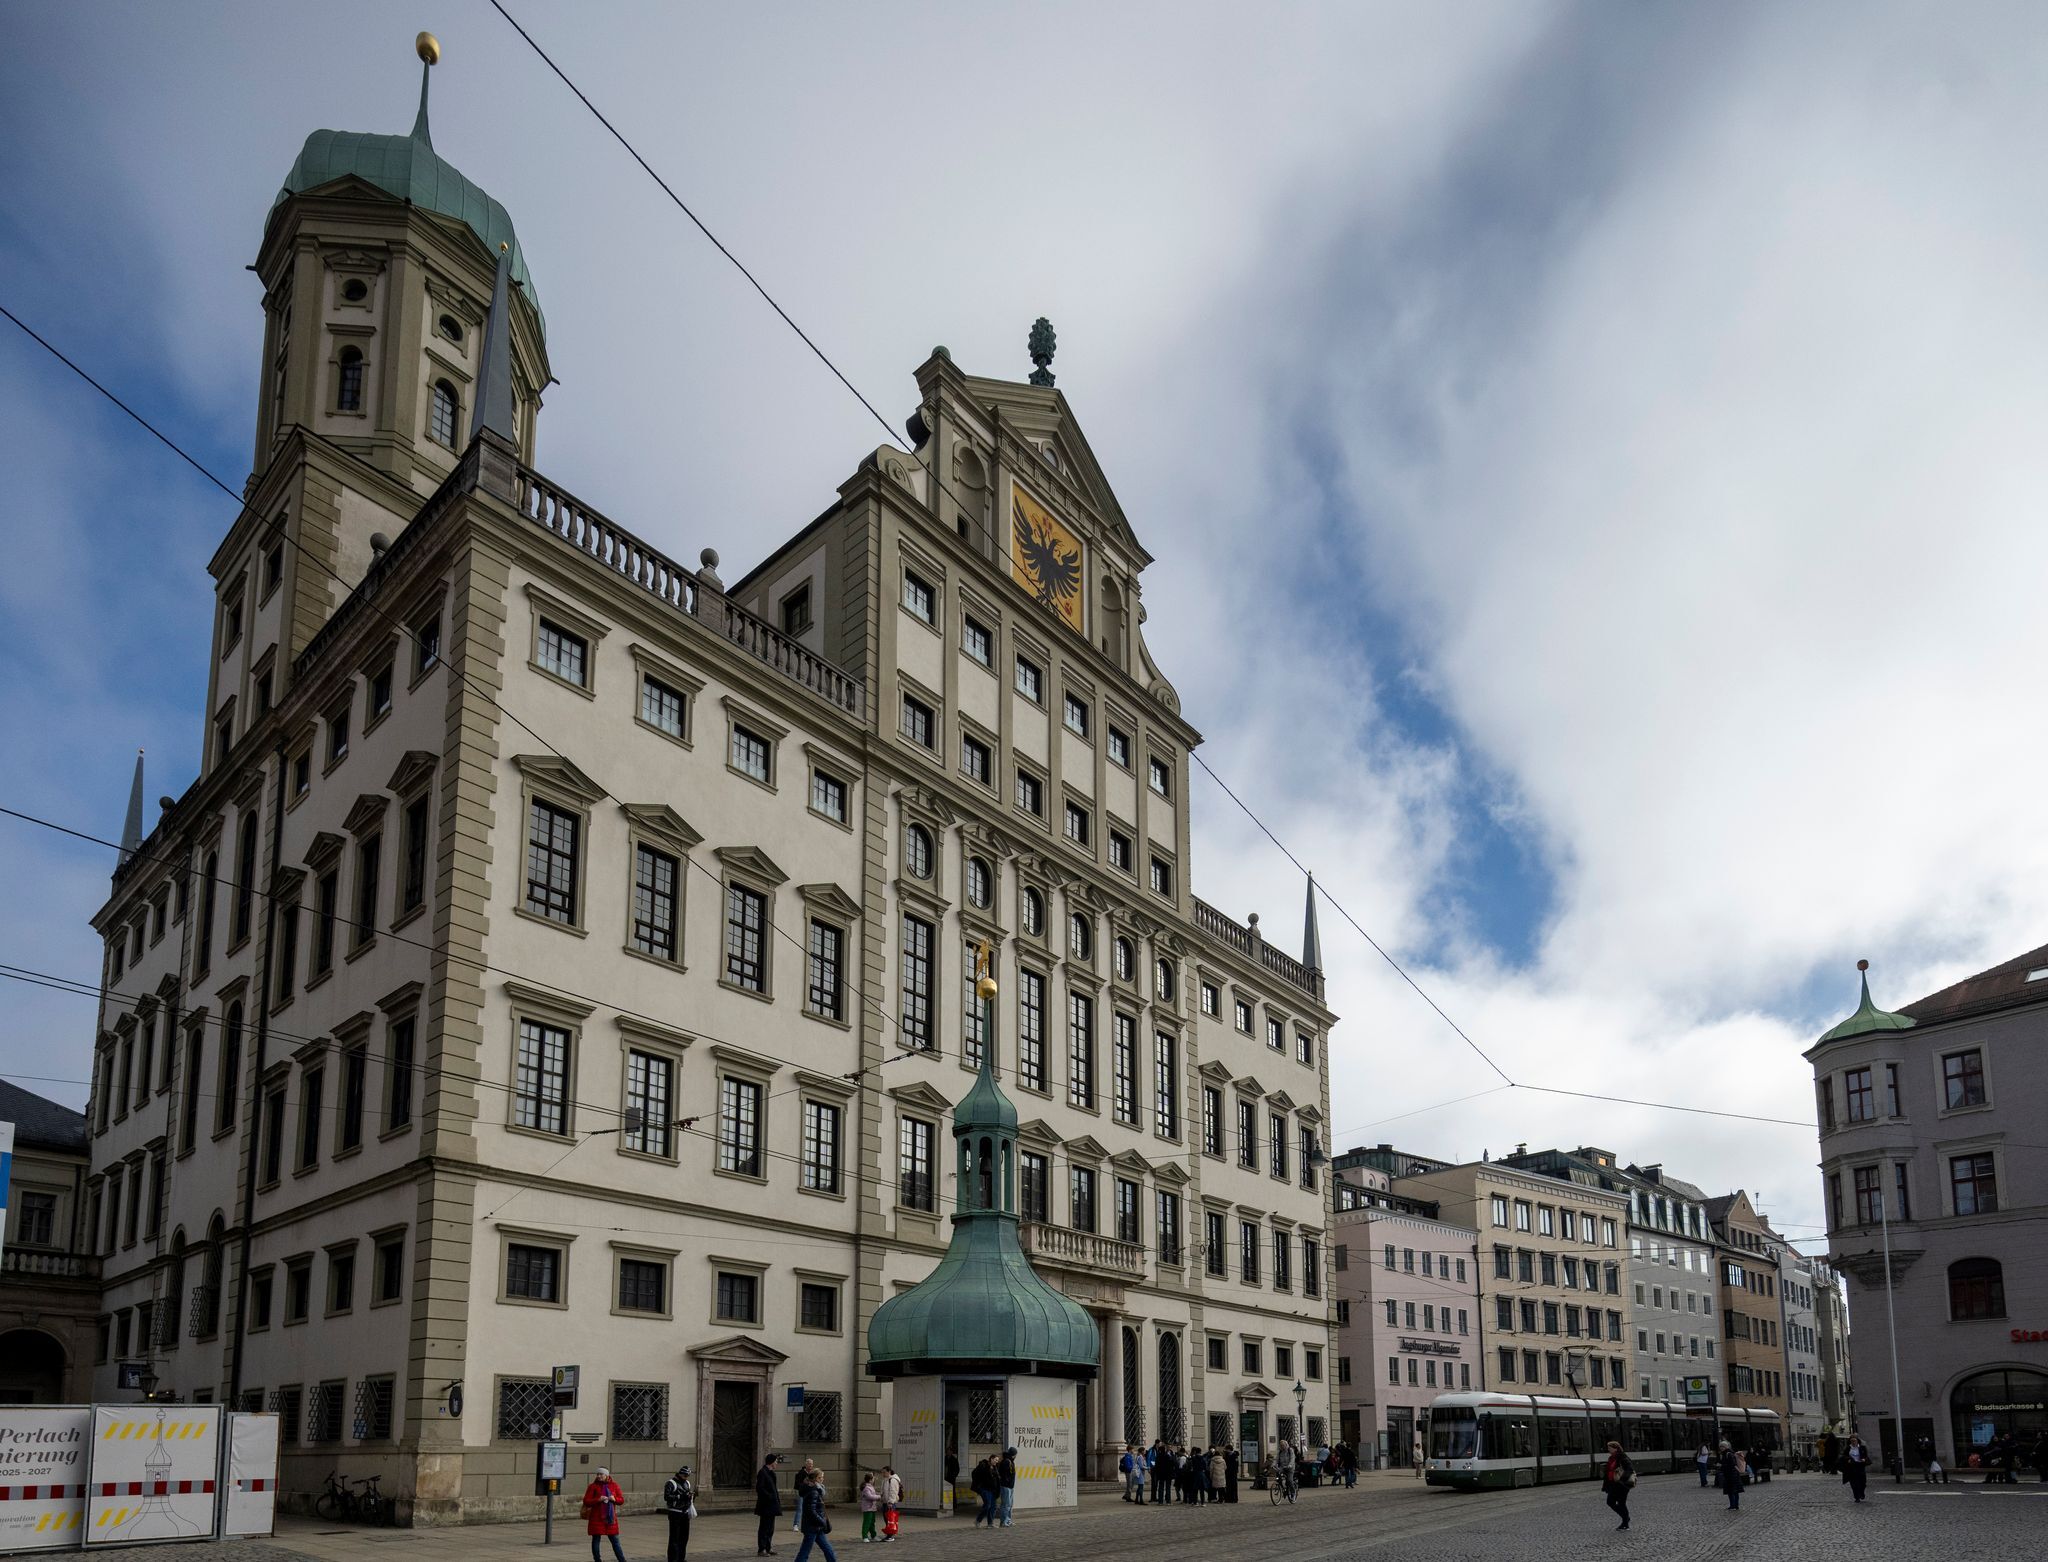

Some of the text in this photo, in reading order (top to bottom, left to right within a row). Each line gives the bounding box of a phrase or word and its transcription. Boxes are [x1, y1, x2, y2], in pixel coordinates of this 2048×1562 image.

[1974, 1403, 2035, 1411] Stadtsparkasse
[0, 1427, 81, 1444] Perlach
[1014, 1427, 1042, 1435] DER NEUE
[1017, 1436, 1055, 1449] Perlach
[0, 1468, 21, 1477] 025
[28, 1467, 52, 1476] 2027
